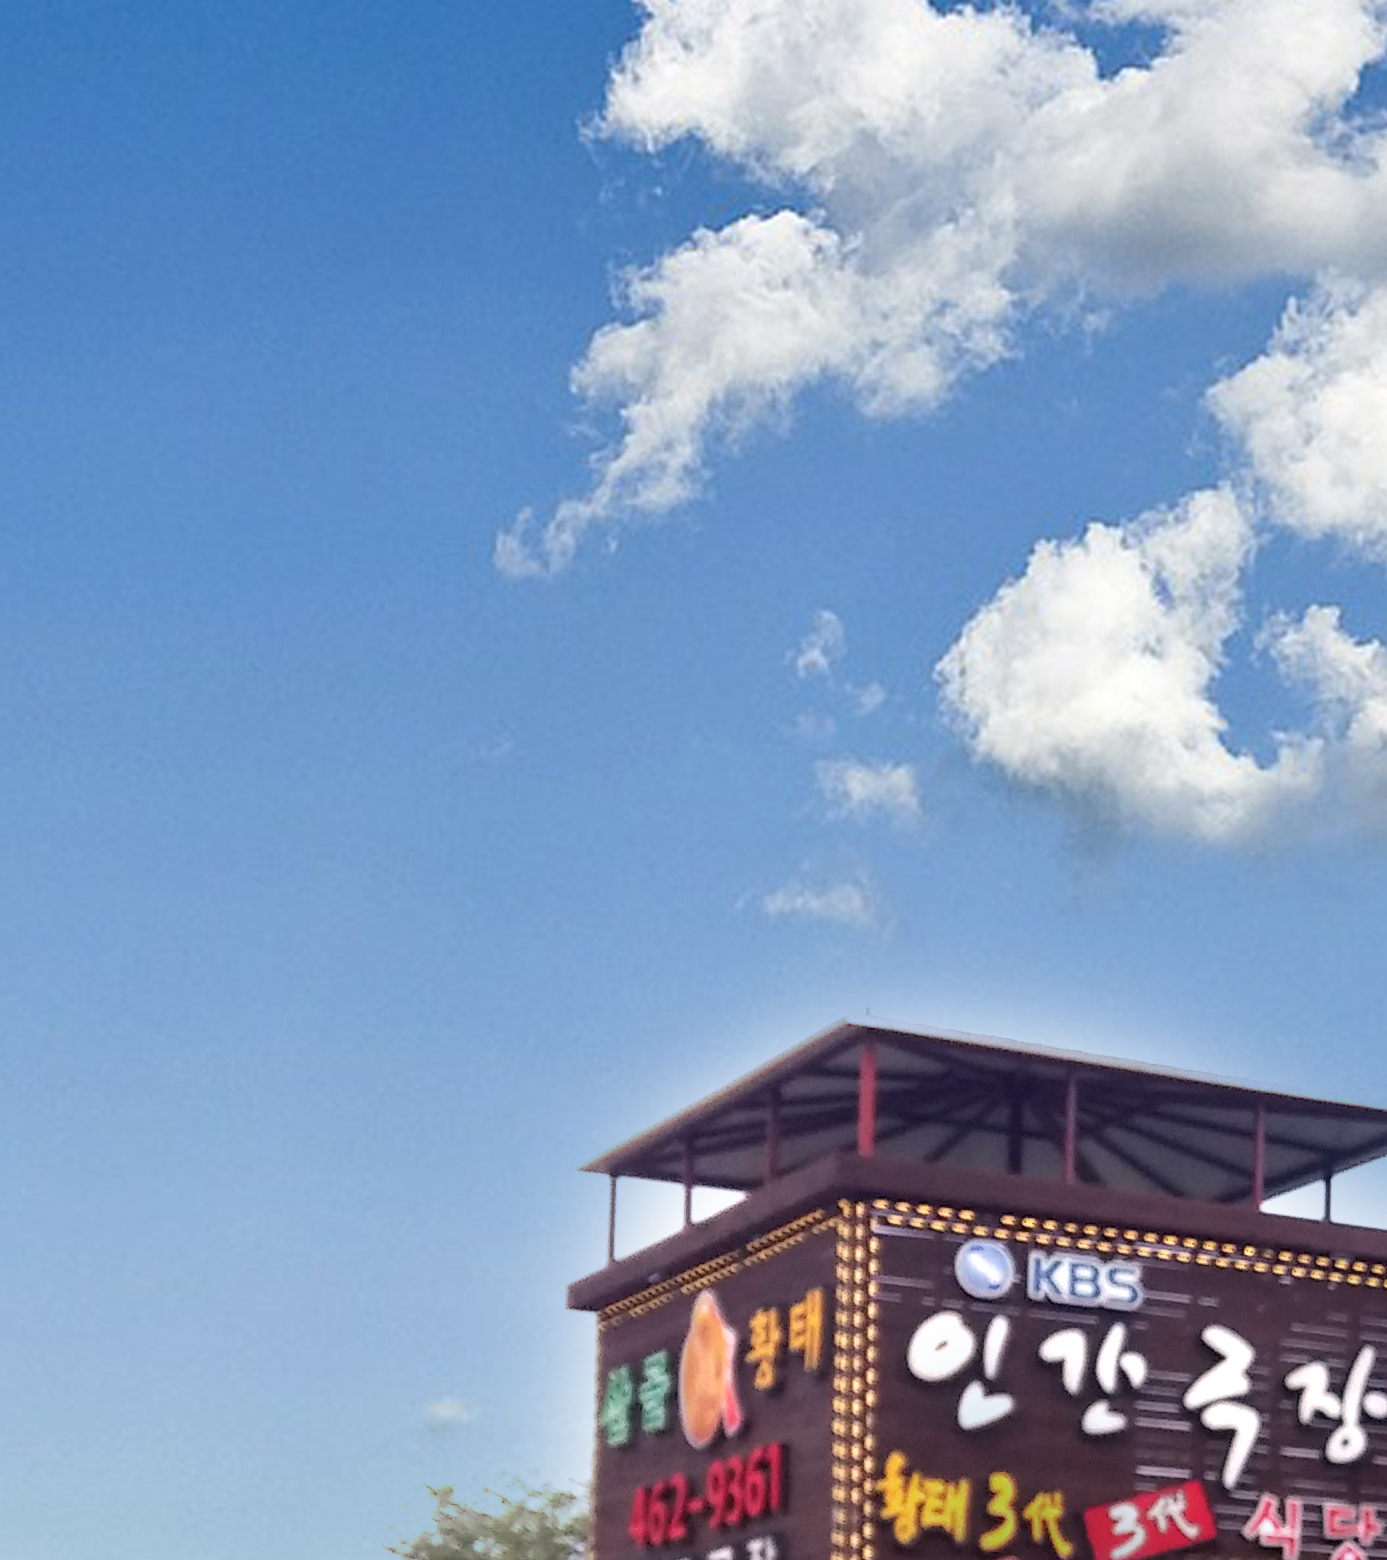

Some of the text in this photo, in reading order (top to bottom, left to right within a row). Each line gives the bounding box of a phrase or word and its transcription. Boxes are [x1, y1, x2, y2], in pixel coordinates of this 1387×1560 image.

[1028, 1252, 1143, 1310] KBS
[601, 1286, 825, 1448] 산골 황태
[628, 1442, 782, 1547] 462-9361
[878, 1451, 972, 1546] 황태
[979, 1471, 1075, 1560] 3代
